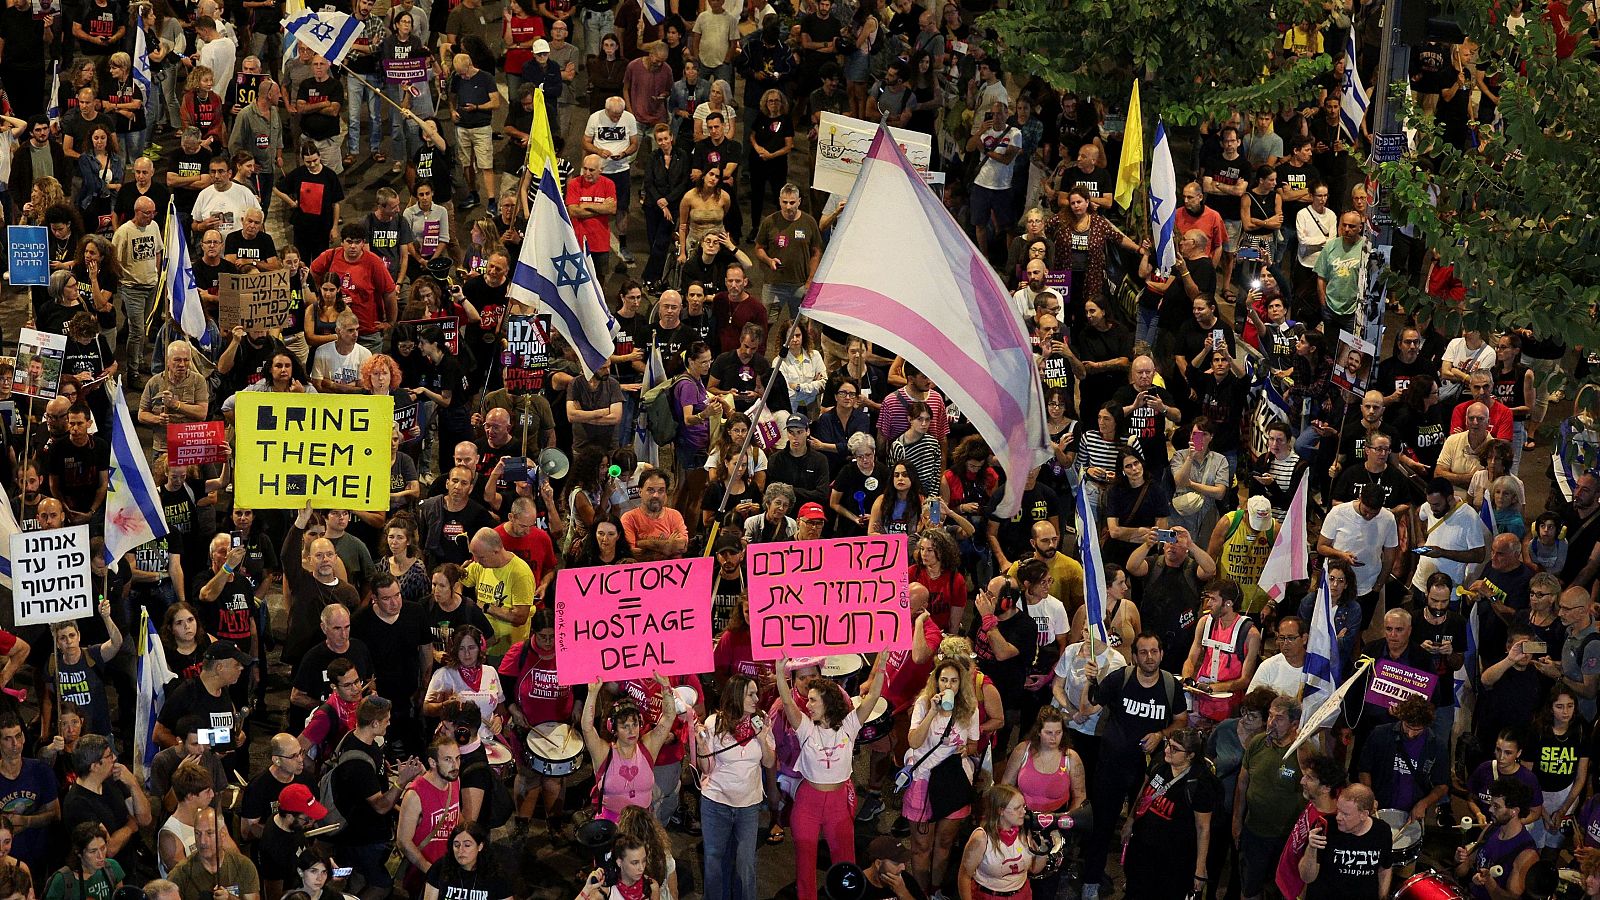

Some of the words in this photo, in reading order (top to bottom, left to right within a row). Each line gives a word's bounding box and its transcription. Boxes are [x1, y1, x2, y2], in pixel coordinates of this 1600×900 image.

[12, 242, 46, 250] מחוייבים
[14, 250, 44, 258] לערבות
[230, 274, 266, 290] מצווה
[248, 300, 289, 318] כפדיון
[444, 332, 456, 340] ELP
[508, 341, 546, 355] חטופים
[1054, 358, 1064, 368] MY
[256, 406, 370, 432] BRING
[1130, 417, 1146, 428] הדור
[179, 447, 202, 456] עסקה
[259, 474, 372, 504] HOME!
[164, 504, 178, 516] GET
[178, 501, 189, 514] MY
[25, 532, 76, 553] אנחנו
[57, 551, 84, 570] פה
[753, 546, 823, 576] עליכם
[834, 540, 900, 573] נגזר
[18, 557, 46, 574] עד
[21, 574, 84, 596] החטוף
[574, 562, 692, 597] VICTORY
[814, 576, 896, 603] להחזיר
[21, 594, 87, 618] האחרון
[757, 584, 804, 613] את
[574, 608, 695, 641] HOSTAGE
[761, 611, 900, 648] החטופים
[560, 632, 568, 652] front
[601, 642, 675, 671] DEAL
[70, 670, 86, 683] למה
[534, 672, 558, 683] PINKFR
[1382, 665, 1404, 675] העסקה
[1414, 674, 1429, 683] לקבל
[60, 681, 89, 695] עדיין
[1123, 697, 1166, 720] חופשי
[1541, 747, 1577, 761] SEAL
[446, 886, 468, 900] בבית
[470, 889, 488, 900] אתם
